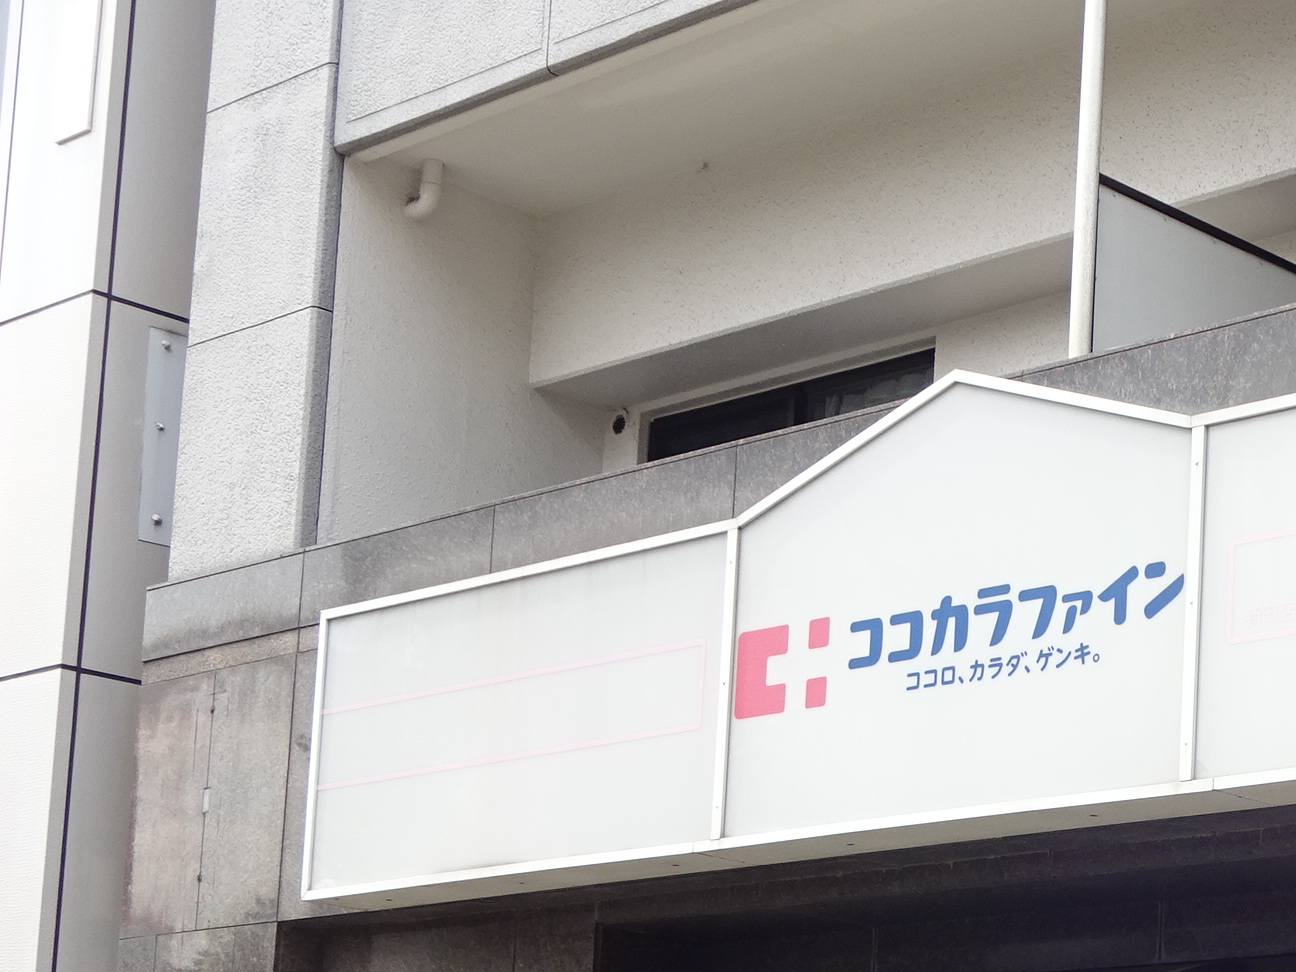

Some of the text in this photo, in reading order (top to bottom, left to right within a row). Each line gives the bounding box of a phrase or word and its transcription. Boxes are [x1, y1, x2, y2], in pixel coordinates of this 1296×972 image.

[848, 561, 1185, 670] ココカラファイン
[906, 642, 1101, 691] ココロ、カラダ、ゲンキ。
